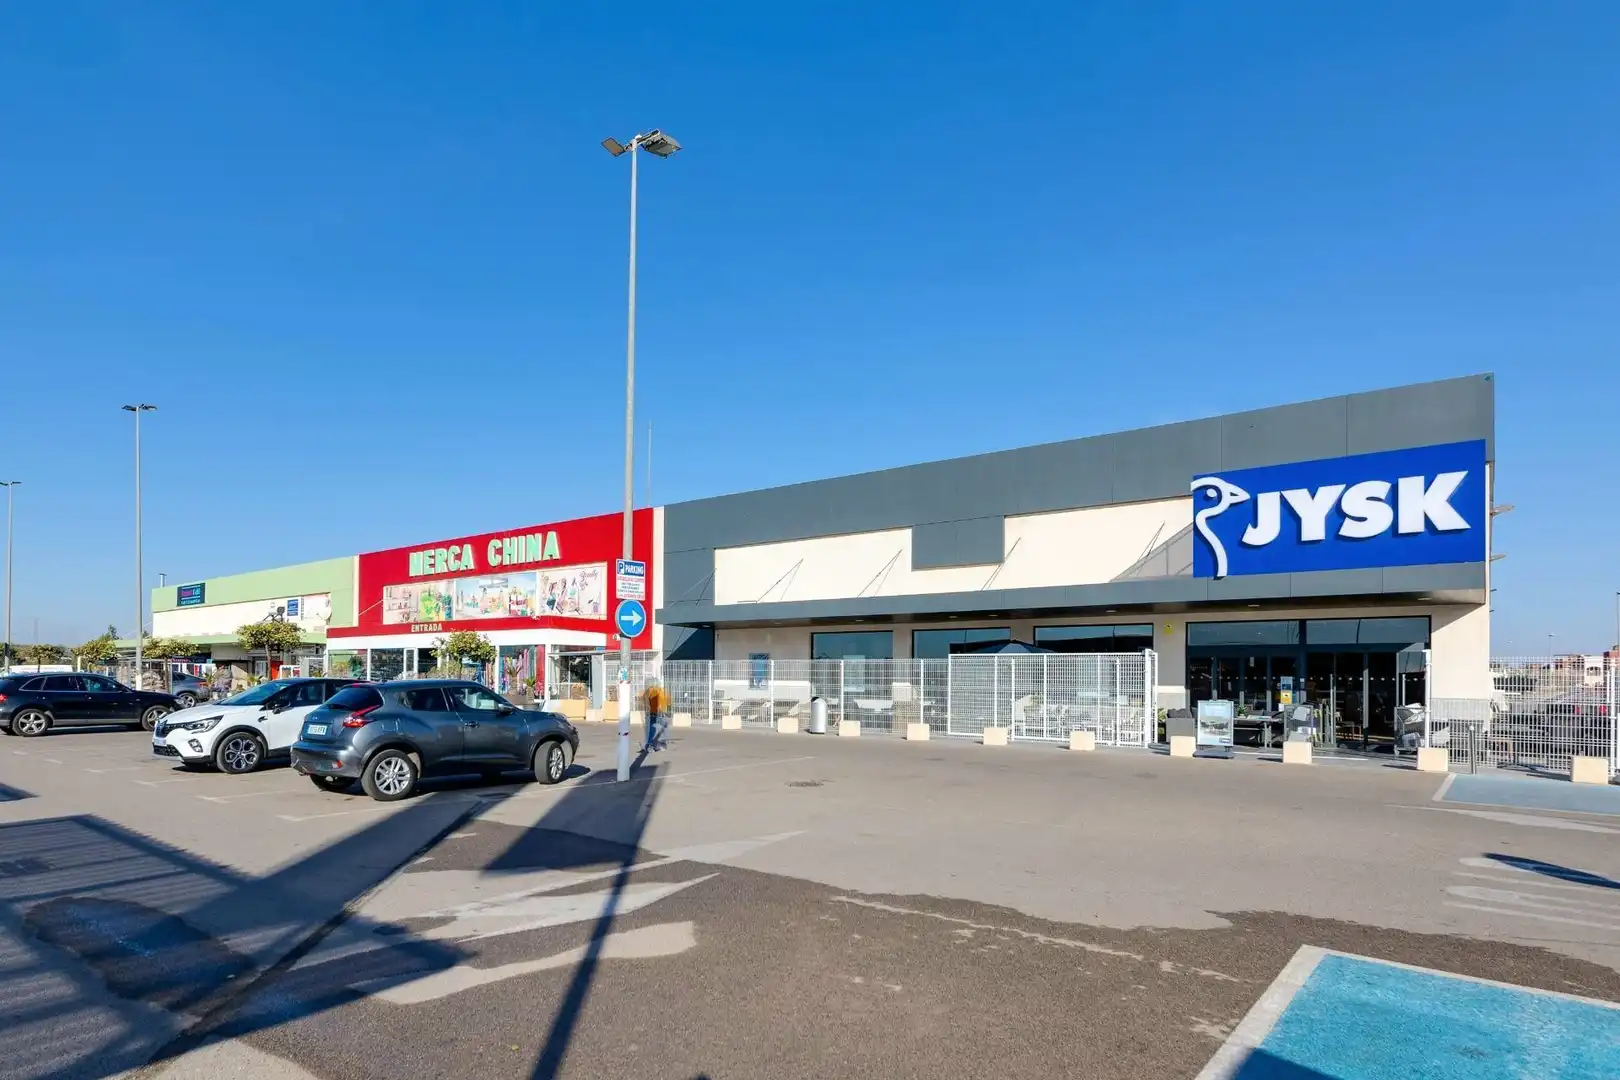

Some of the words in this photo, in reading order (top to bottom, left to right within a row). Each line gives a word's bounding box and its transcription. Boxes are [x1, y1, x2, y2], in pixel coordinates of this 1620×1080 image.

[1241, 470, 1471, 546] JYSK
[409, 543, 475, 577] MERCA
[487, 530, 560, 567] CHINA
[625, 564, 644, 575] PARKING
[411, 622, 443, 633] ENTRADA
